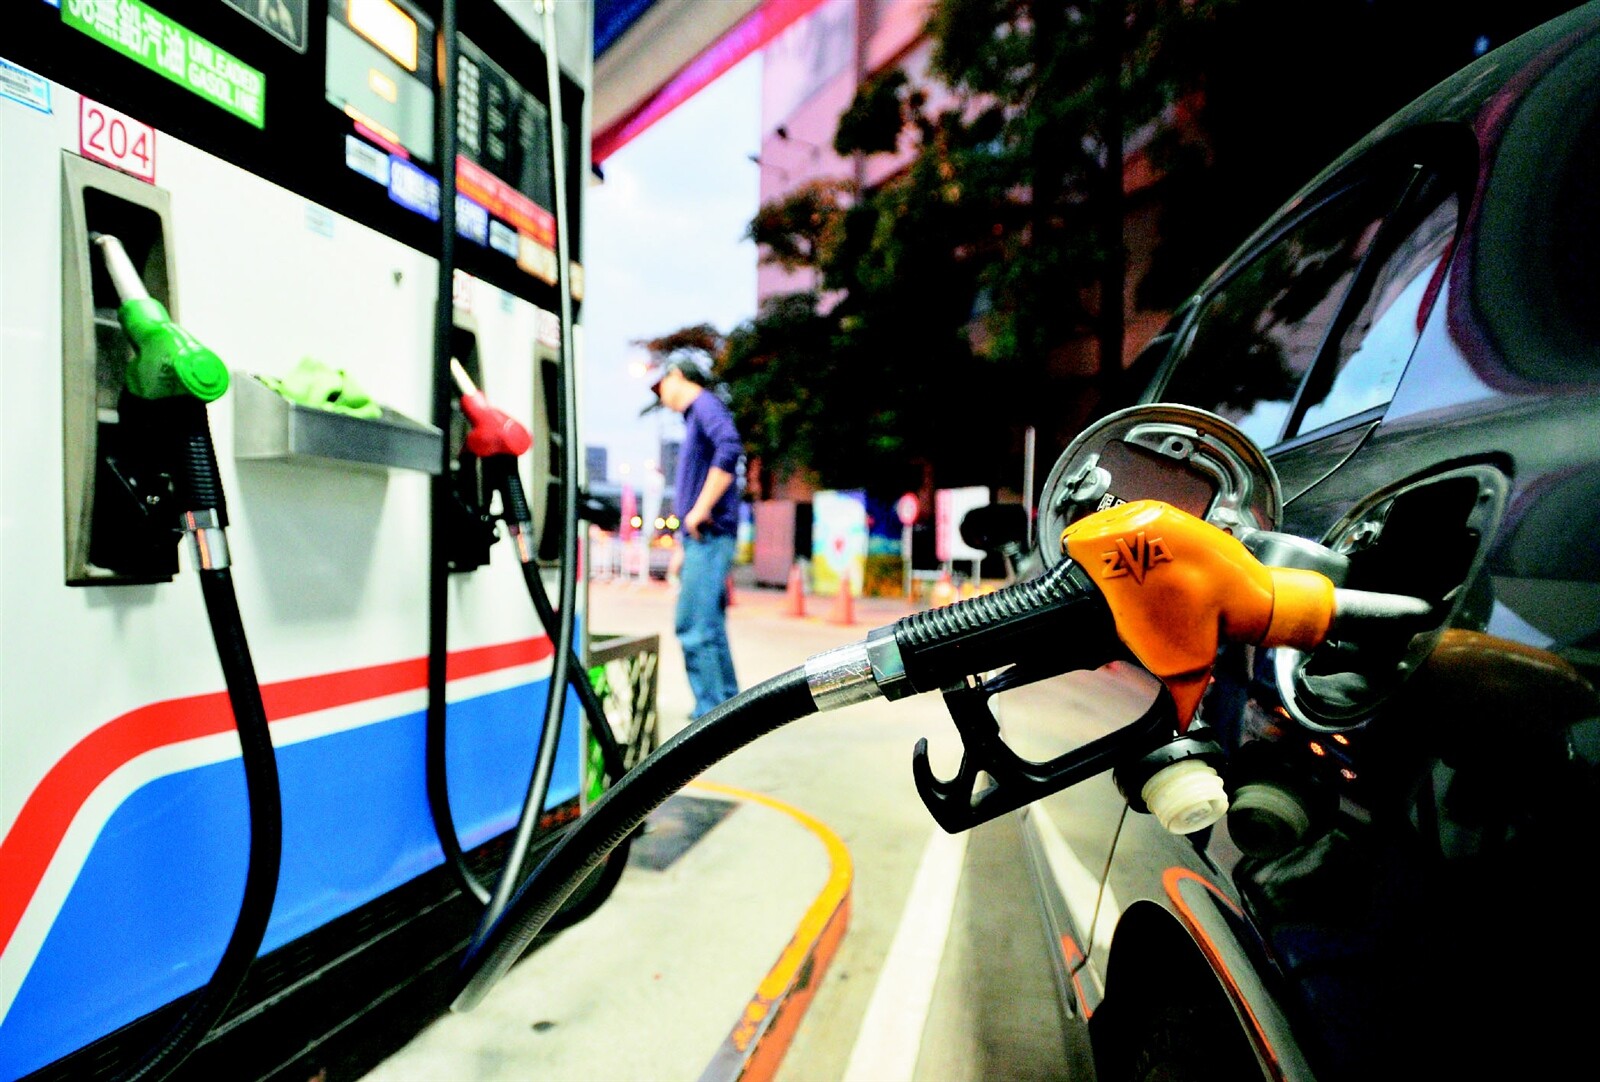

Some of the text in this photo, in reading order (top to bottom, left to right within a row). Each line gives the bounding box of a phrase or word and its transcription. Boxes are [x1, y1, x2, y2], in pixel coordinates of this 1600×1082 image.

[187, 37, 260, 94] UNLEADED
[187, 63, 259, 120] GASOLINE
[88, 109, 149, 168] 204
[1102, 532, 1173, 585] ZVA
